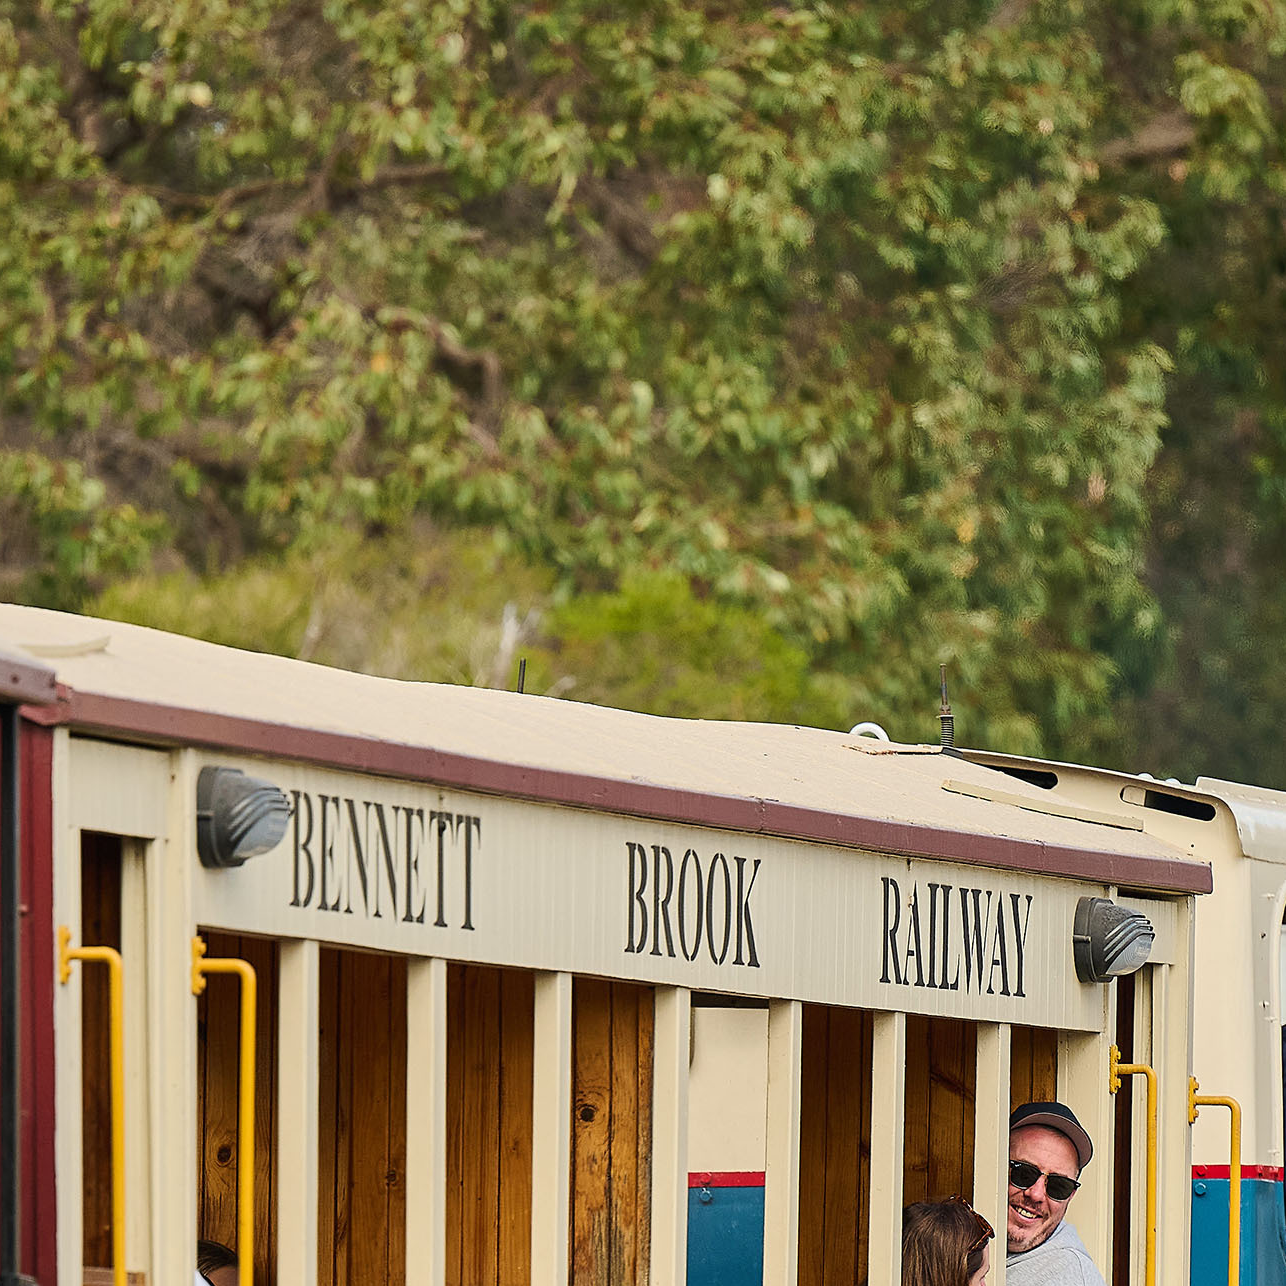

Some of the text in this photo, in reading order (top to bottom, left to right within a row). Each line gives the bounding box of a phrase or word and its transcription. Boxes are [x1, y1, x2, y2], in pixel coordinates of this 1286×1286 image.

[289, 789, 1033, 998] BENNETT BROOK RAILWAY
